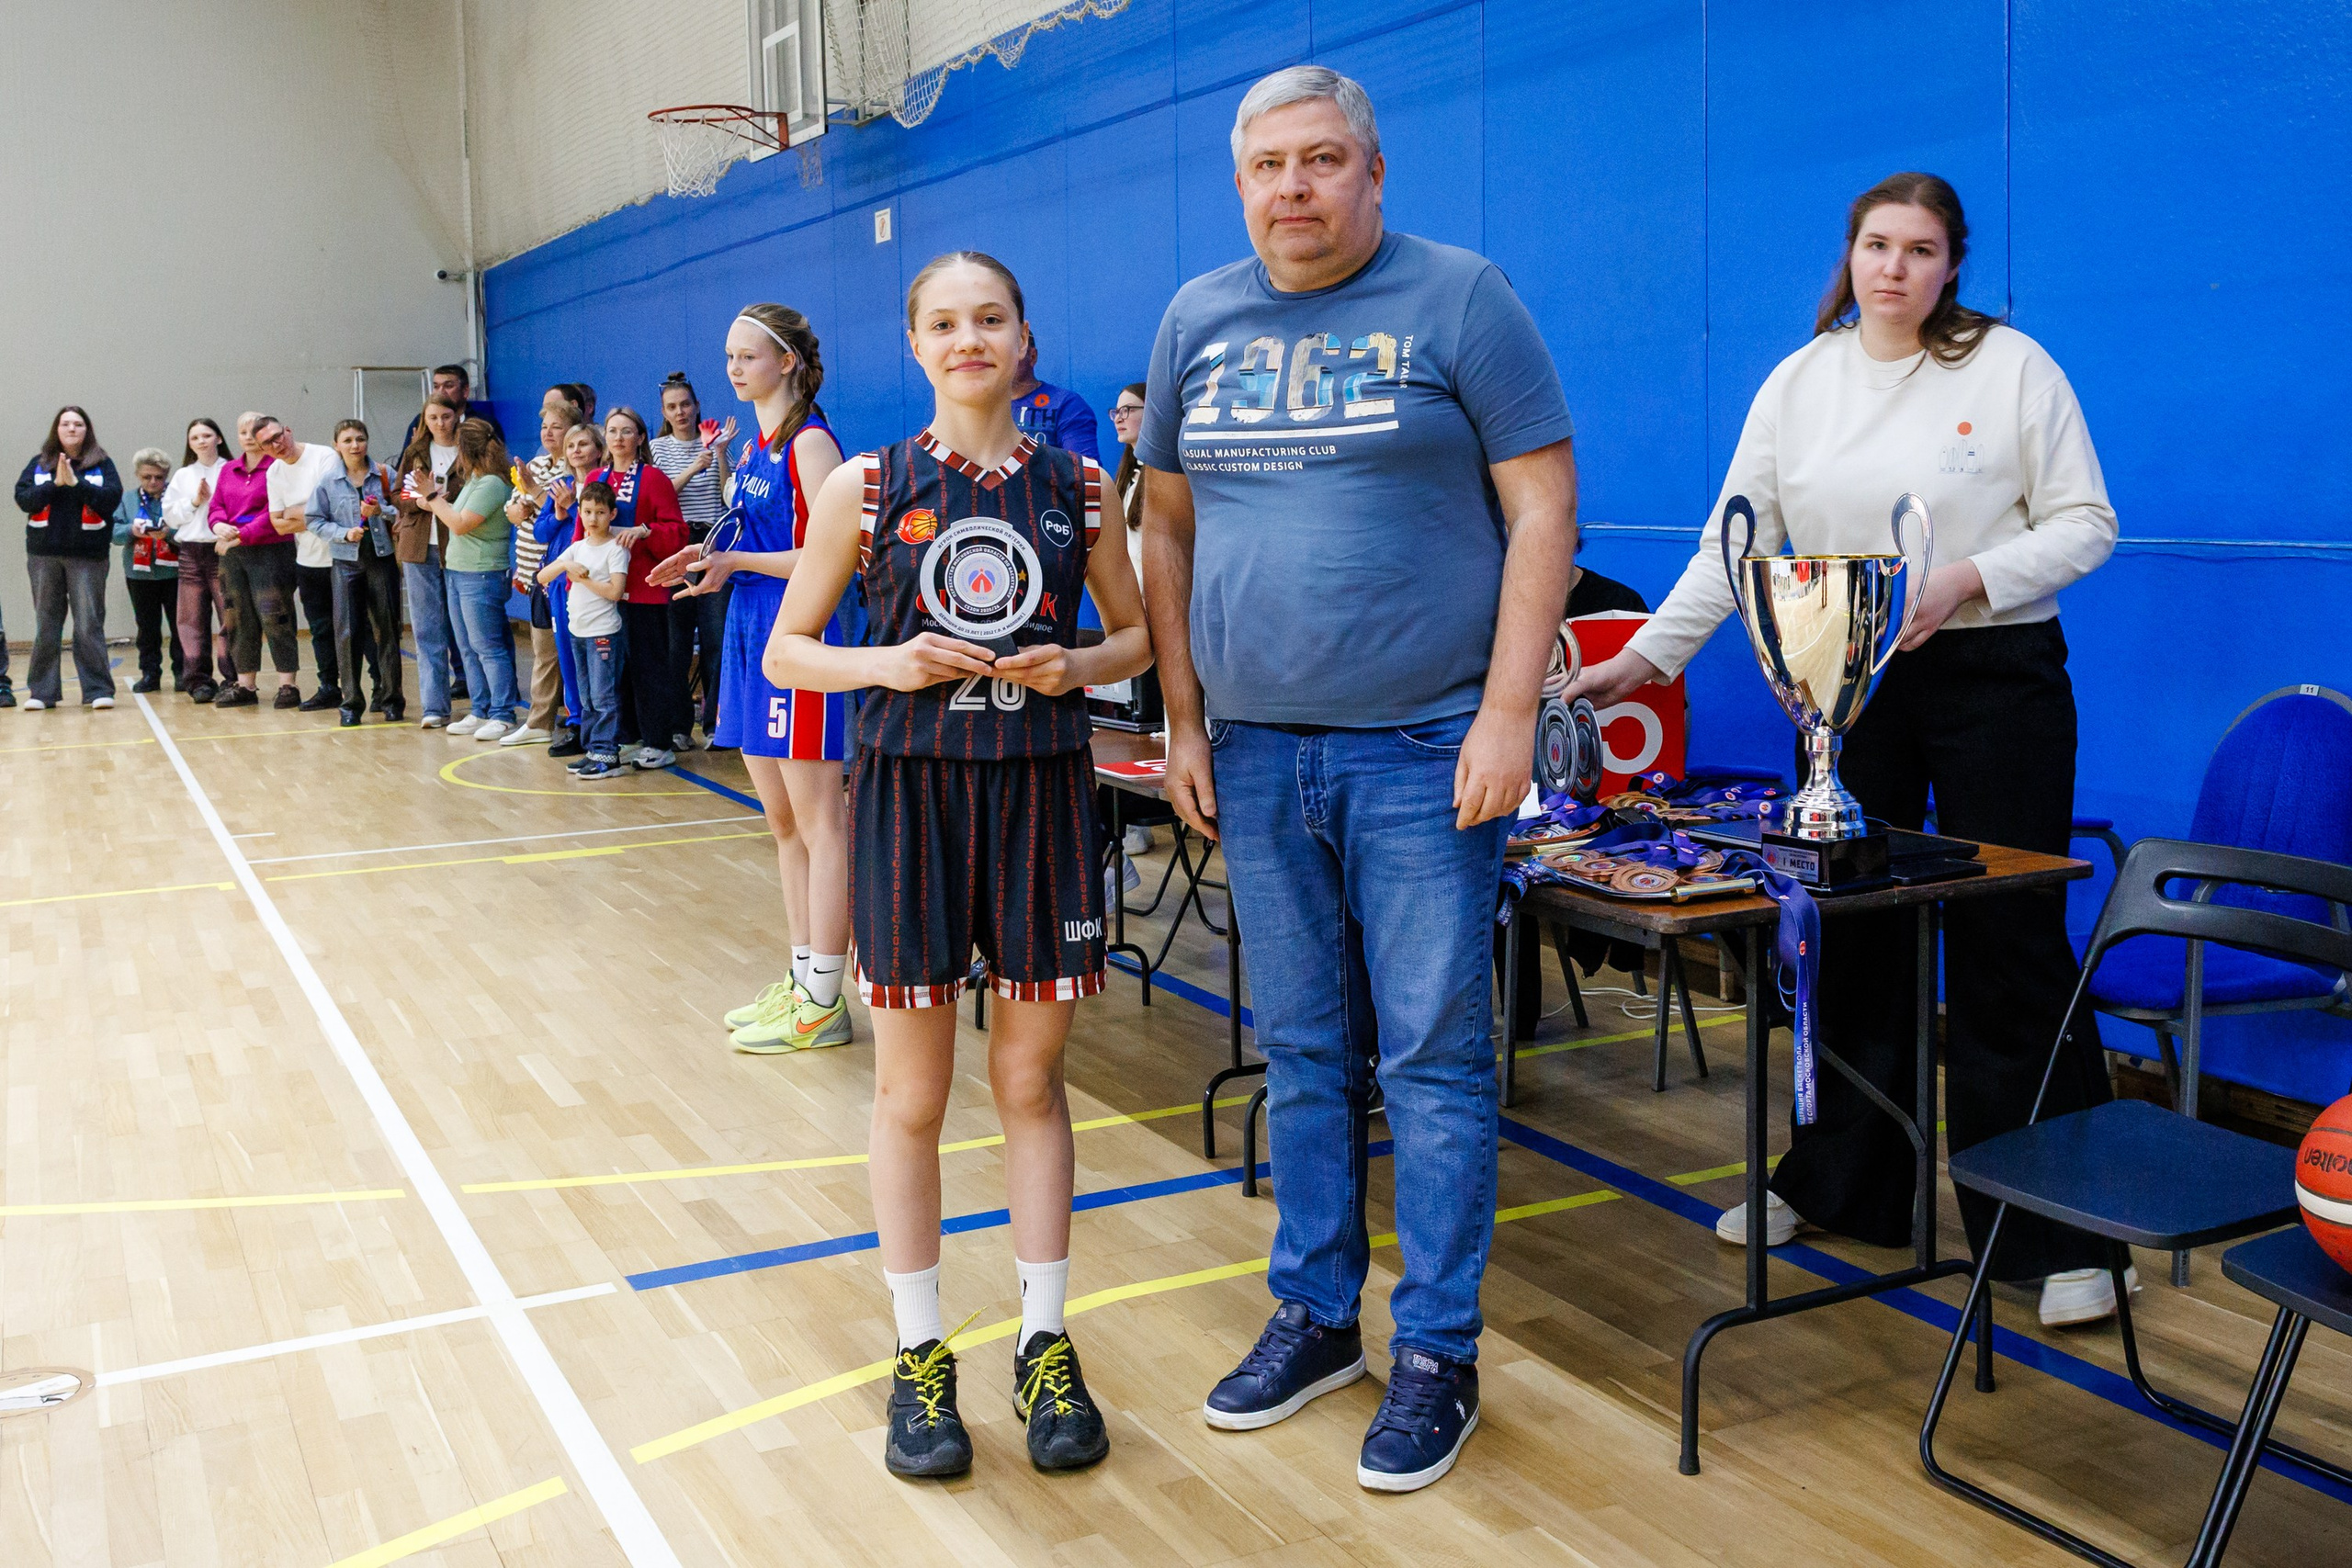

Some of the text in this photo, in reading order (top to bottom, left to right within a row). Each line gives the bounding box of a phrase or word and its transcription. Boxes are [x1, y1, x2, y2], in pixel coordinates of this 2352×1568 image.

[1401, 334, 1414, 358] TOM
[1186, 332, 1397, 424] 1962
[1215, 446, 1306, 458] MANUFACTURING
[1308, 445, 1337, 456] CLUB
[1186, 461, 1304, 472] CLASSIC CUSTOM DESIGN
[741, 473, 771, 499] ИЩИ
[937, 525, 1026, 551] ИГРОК СИМВОЛИЧЕСКОЙ ПЯТЕРКИ
[1045, 520, 1070, 536] РФБ
[964, 604, 980, 613] СЕЗОН
[767, 696, 787, 739] 5
[1789, 858, 1815, 872] МЕСТО
[1064, 917, 1102, 942] ШФК
[1803, 1037, 1812, 1089] МОСКОВСКОЙ
[1805, 1090, 1814, 1117] СПОРТА
[2303, 1147, 2352, 1175] olten
